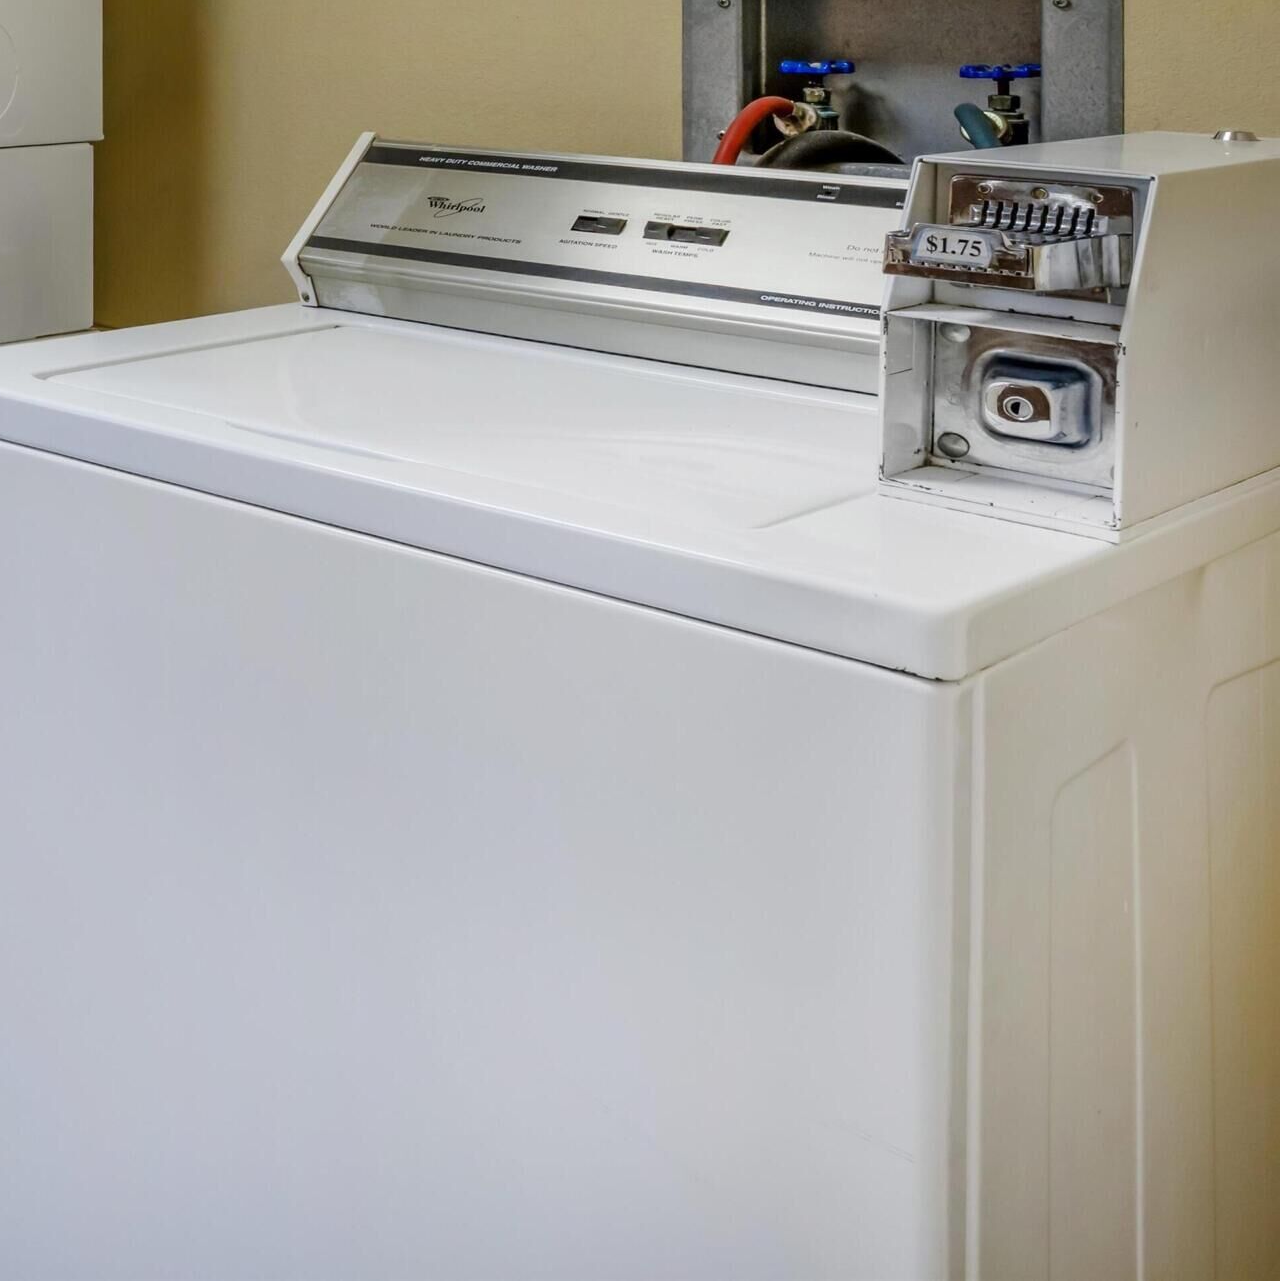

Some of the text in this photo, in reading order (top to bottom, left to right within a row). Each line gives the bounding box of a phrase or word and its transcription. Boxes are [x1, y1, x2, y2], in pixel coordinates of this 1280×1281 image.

[419, 156, 446, 164] HEAVY
[445, 158, 468, 166] DUTY
[467, 160, 520, 169] COMMERCIAL
[428, 198, 487, 216] Whirlpool
[398, 226, 428, 234] LEADER
[439, 231, 475, 239] LAUNDRY
[476, 235, 522, 244] PRODUCTS
[558, 238, 618, 249] AGITATION SPEED
[863, 245, 880, 253] not
[925, 233, 983, 259] $1.75
[760, 295, 880, 316] OPERATING INSTRUCTIO
